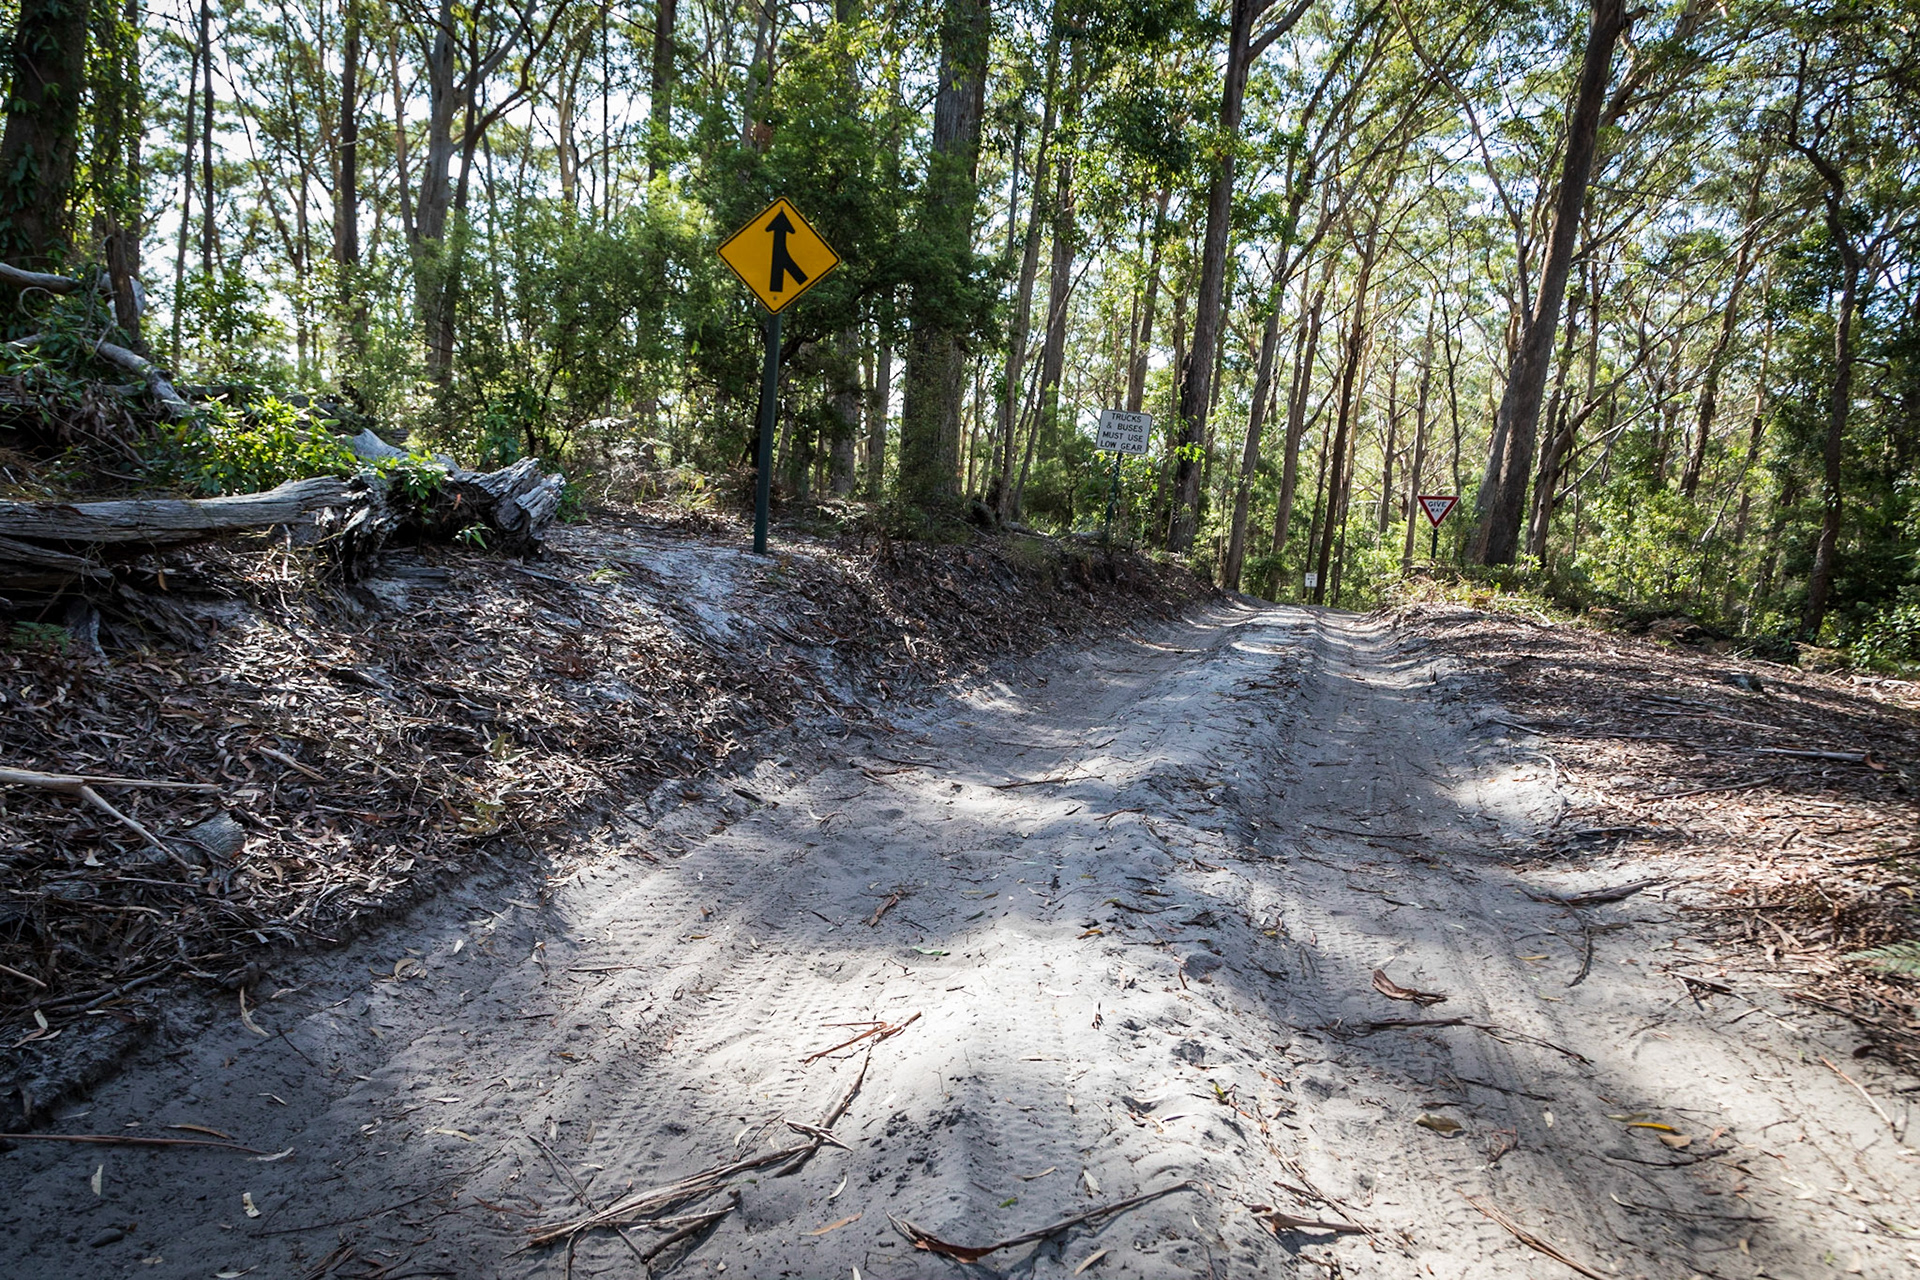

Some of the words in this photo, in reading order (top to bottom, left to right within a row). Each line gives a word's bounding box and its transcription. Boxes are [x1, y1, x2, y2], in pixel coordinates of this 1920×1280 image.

[1112, 413, 1142, 423] TRUCKS
[1117, 423, 1144, 433] BUSES
[1102, 431, 1124, 440] MUST
[1128, 434, 1144, 443] USE
[1100, 440, 1117, 449] LOW
[1120, 442, 1143, 451] GEAR
